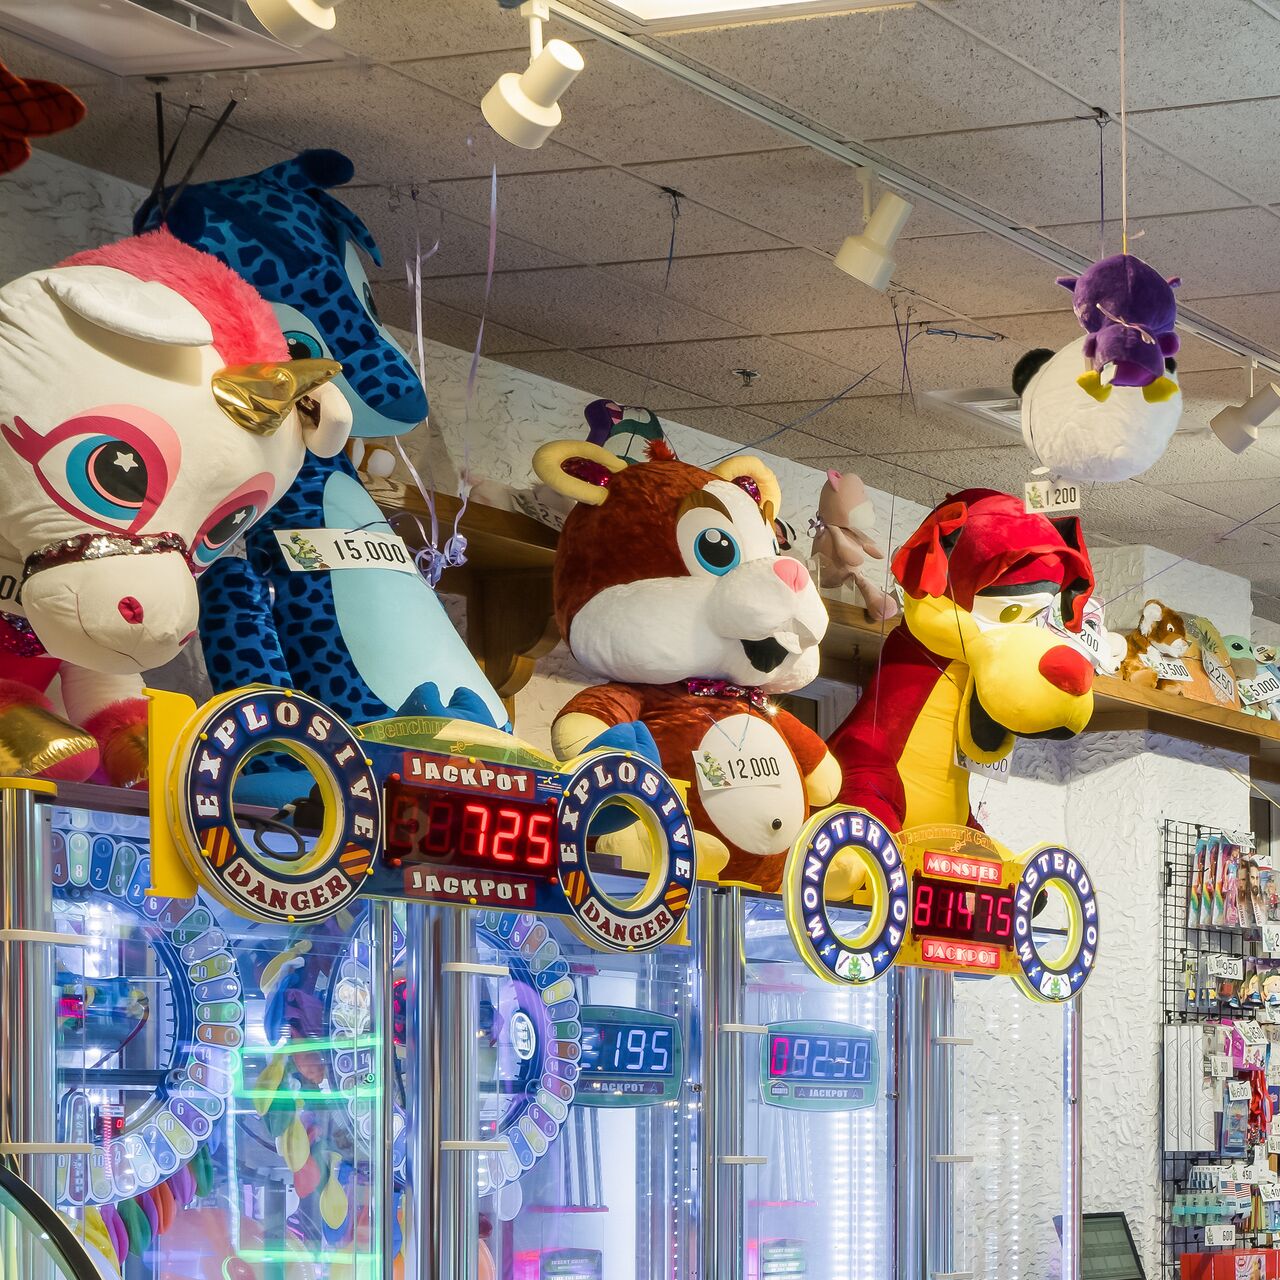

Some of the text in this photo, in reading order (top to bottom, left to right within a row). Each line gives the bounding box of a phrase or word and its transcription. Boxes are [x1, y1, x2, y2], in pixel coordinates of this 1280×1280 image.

[1044, 485, 1077, 506] 1,200
[333, 538, 406, 564] 15,000
[1250, 678, 1279, 697] 5,000
[196, 701, 375, 839] EXPLOSIVE
[411, 757, 529, 793] JACKPOT
[727, 755, 780, 780] 12,000
[560, 761, 691, 879] EXPLOSIVE
[464, 804, 552, 866] 725
[55, 864, 62, 876] 4
[75, 865, 83, 878] 8
[95, 867, 102, 880] 2
[926, 858, 999, 881] MONSTER
[133, 884, 140, 897] 2
[228, 861, 349, 912] DANGER
[411, 870, 529, 901] JACKPOT
[803, 815, 906, 947] MONSTER DROP
[149, 897, 157, 910] 6
[914, 885, 1012, 937] 81475
[1015, 853, 1097, 968] MONSTER DROP
[582, 899, 672, 943] DANGER
[925, 943, 998, 965] JACKPOT
[1223, 962, 1239, 976] 950
[201, 986, 208, 999] 2
[203, 1006, 211, 1019] 8
[204, 1027, 212, 1039] 4
[809, 1089, 848, 1098] JACKPOT
[177, 1102, 185, 1115] 6
[163, 1119, 174, 1131] 10
